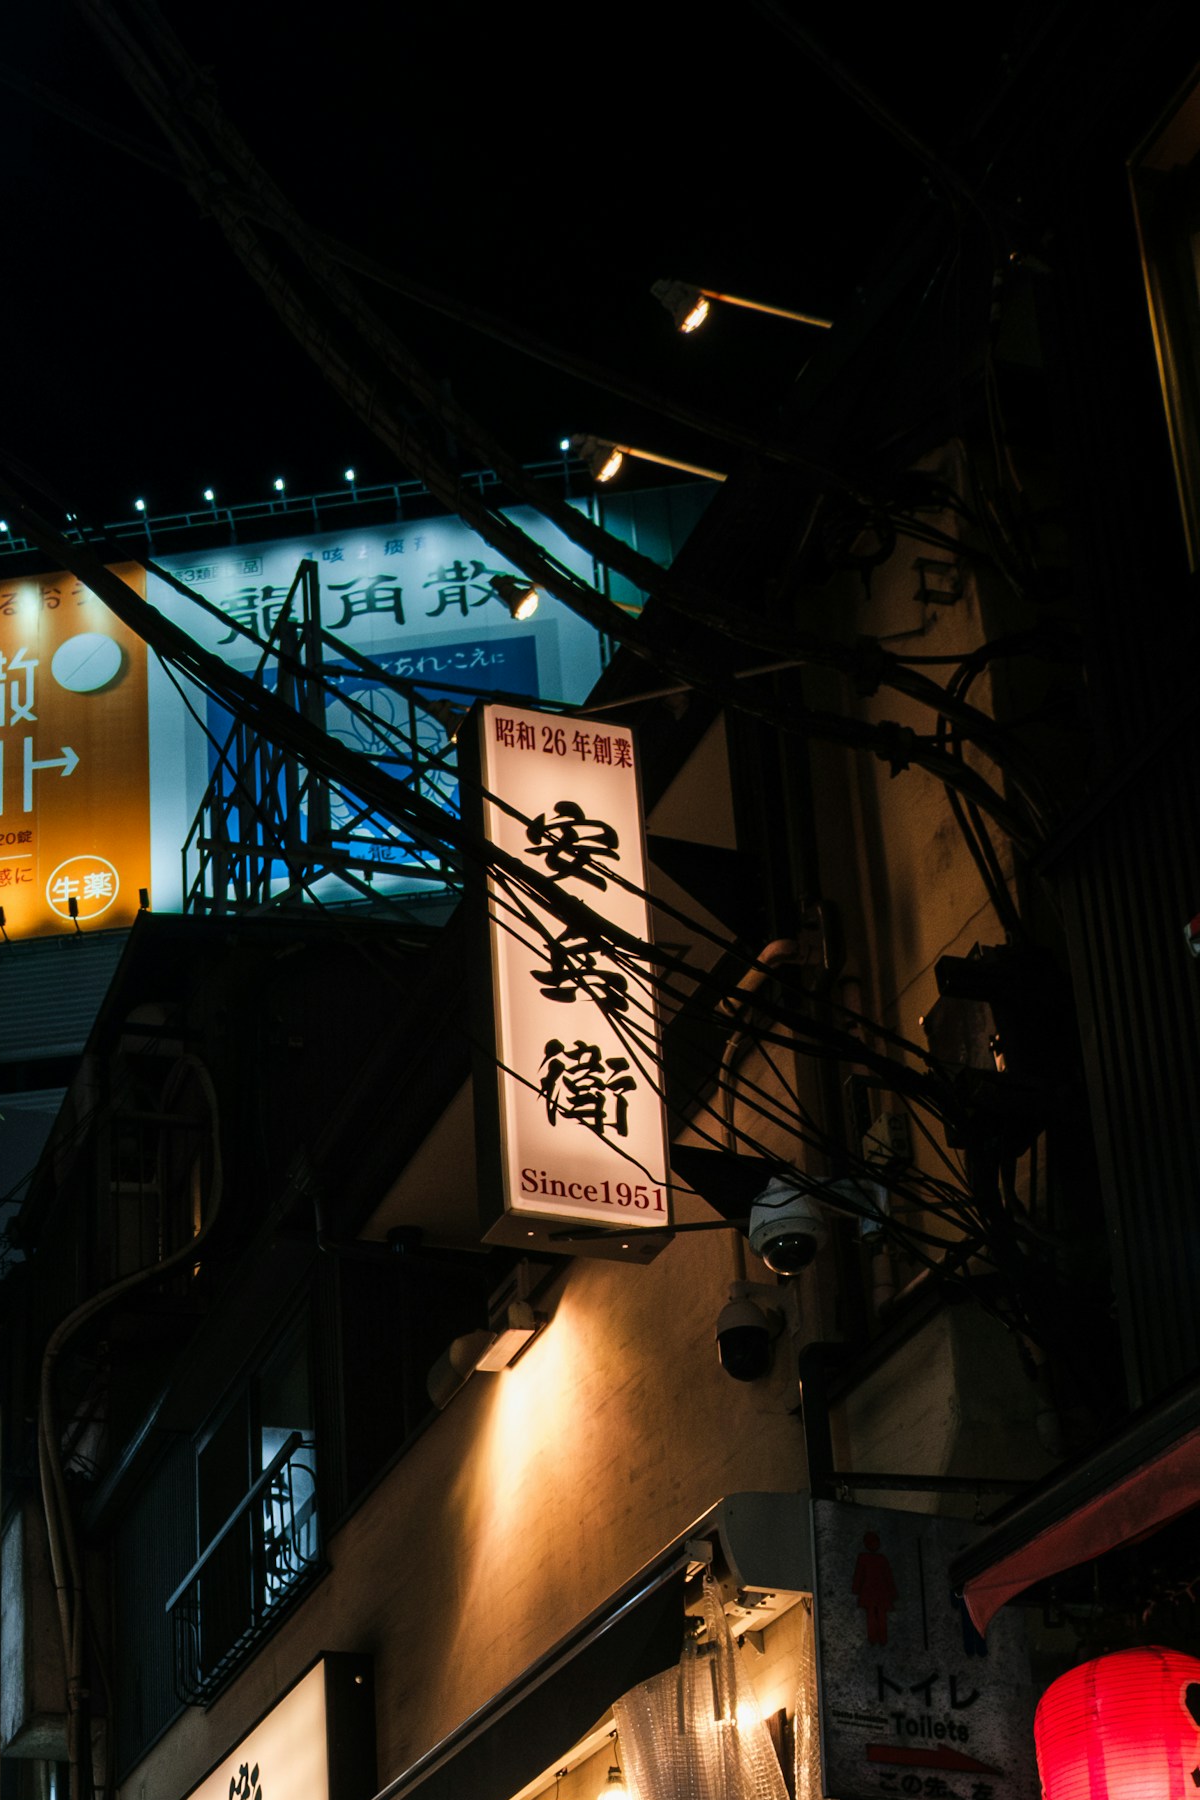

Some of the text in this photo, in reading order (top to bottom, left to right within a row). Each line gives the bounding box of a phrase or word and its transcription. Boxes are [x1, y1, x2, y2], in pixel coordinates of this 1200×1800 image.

[52, 871, 114, 903] 生薬
[877, 1664, 981, 1710] トイレ
[891, 1711, 970, 1743] Toilets
